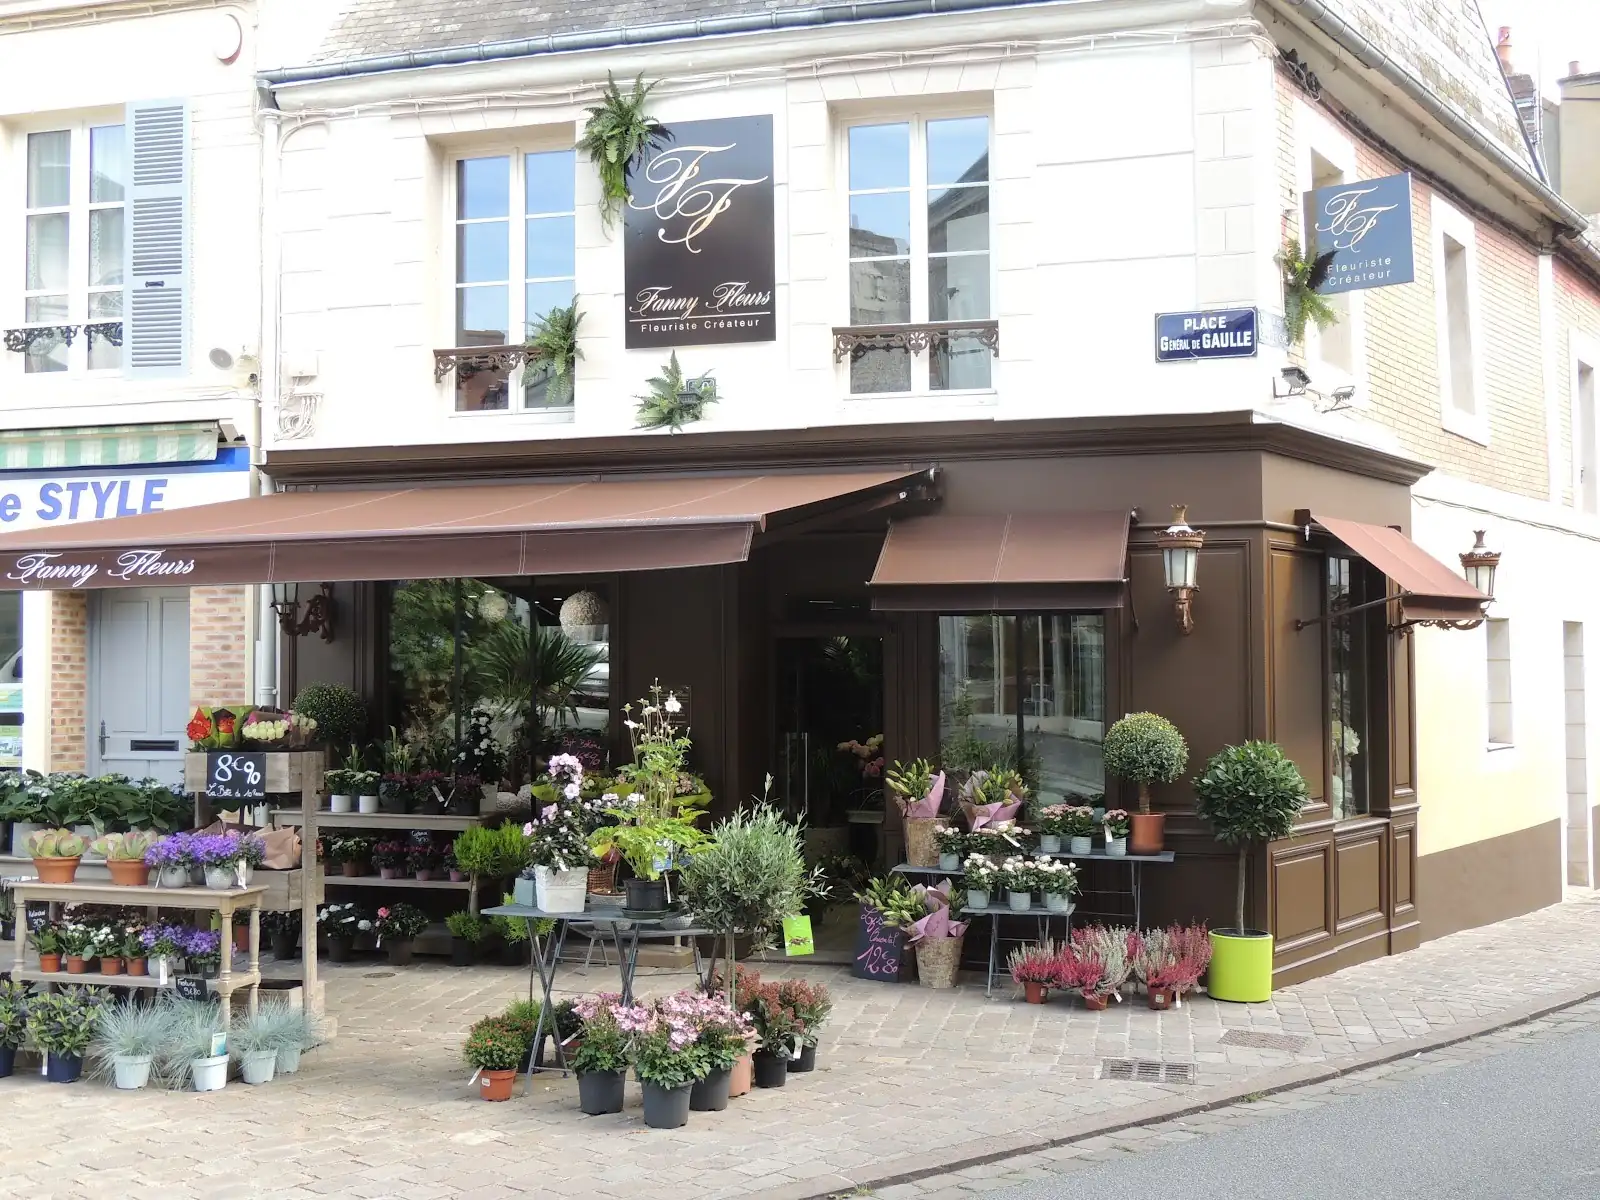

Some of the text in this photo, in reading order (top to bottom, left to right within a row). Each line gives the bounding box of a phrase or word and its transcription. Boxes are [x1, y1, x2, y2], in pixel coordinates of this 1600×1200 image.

[1327, 257, 1391, 273] Fleuriste
[1329, 270, 1391, 285] Créateur
[629, 281, 771, 320] Fanny Fleurs
[641, 319, 760, 332] Fleuriste Créateur
[1184, 316, 1226, 330] PLACE
[1192, 340, 1200, 350] DE
[1202, 331, 1252, 349] GAULLE
[36, 479, 168, 520] STYLE
[7, 549, 195, 587] Fanny Fleurs
[860, 906, 884, 933] Lys
